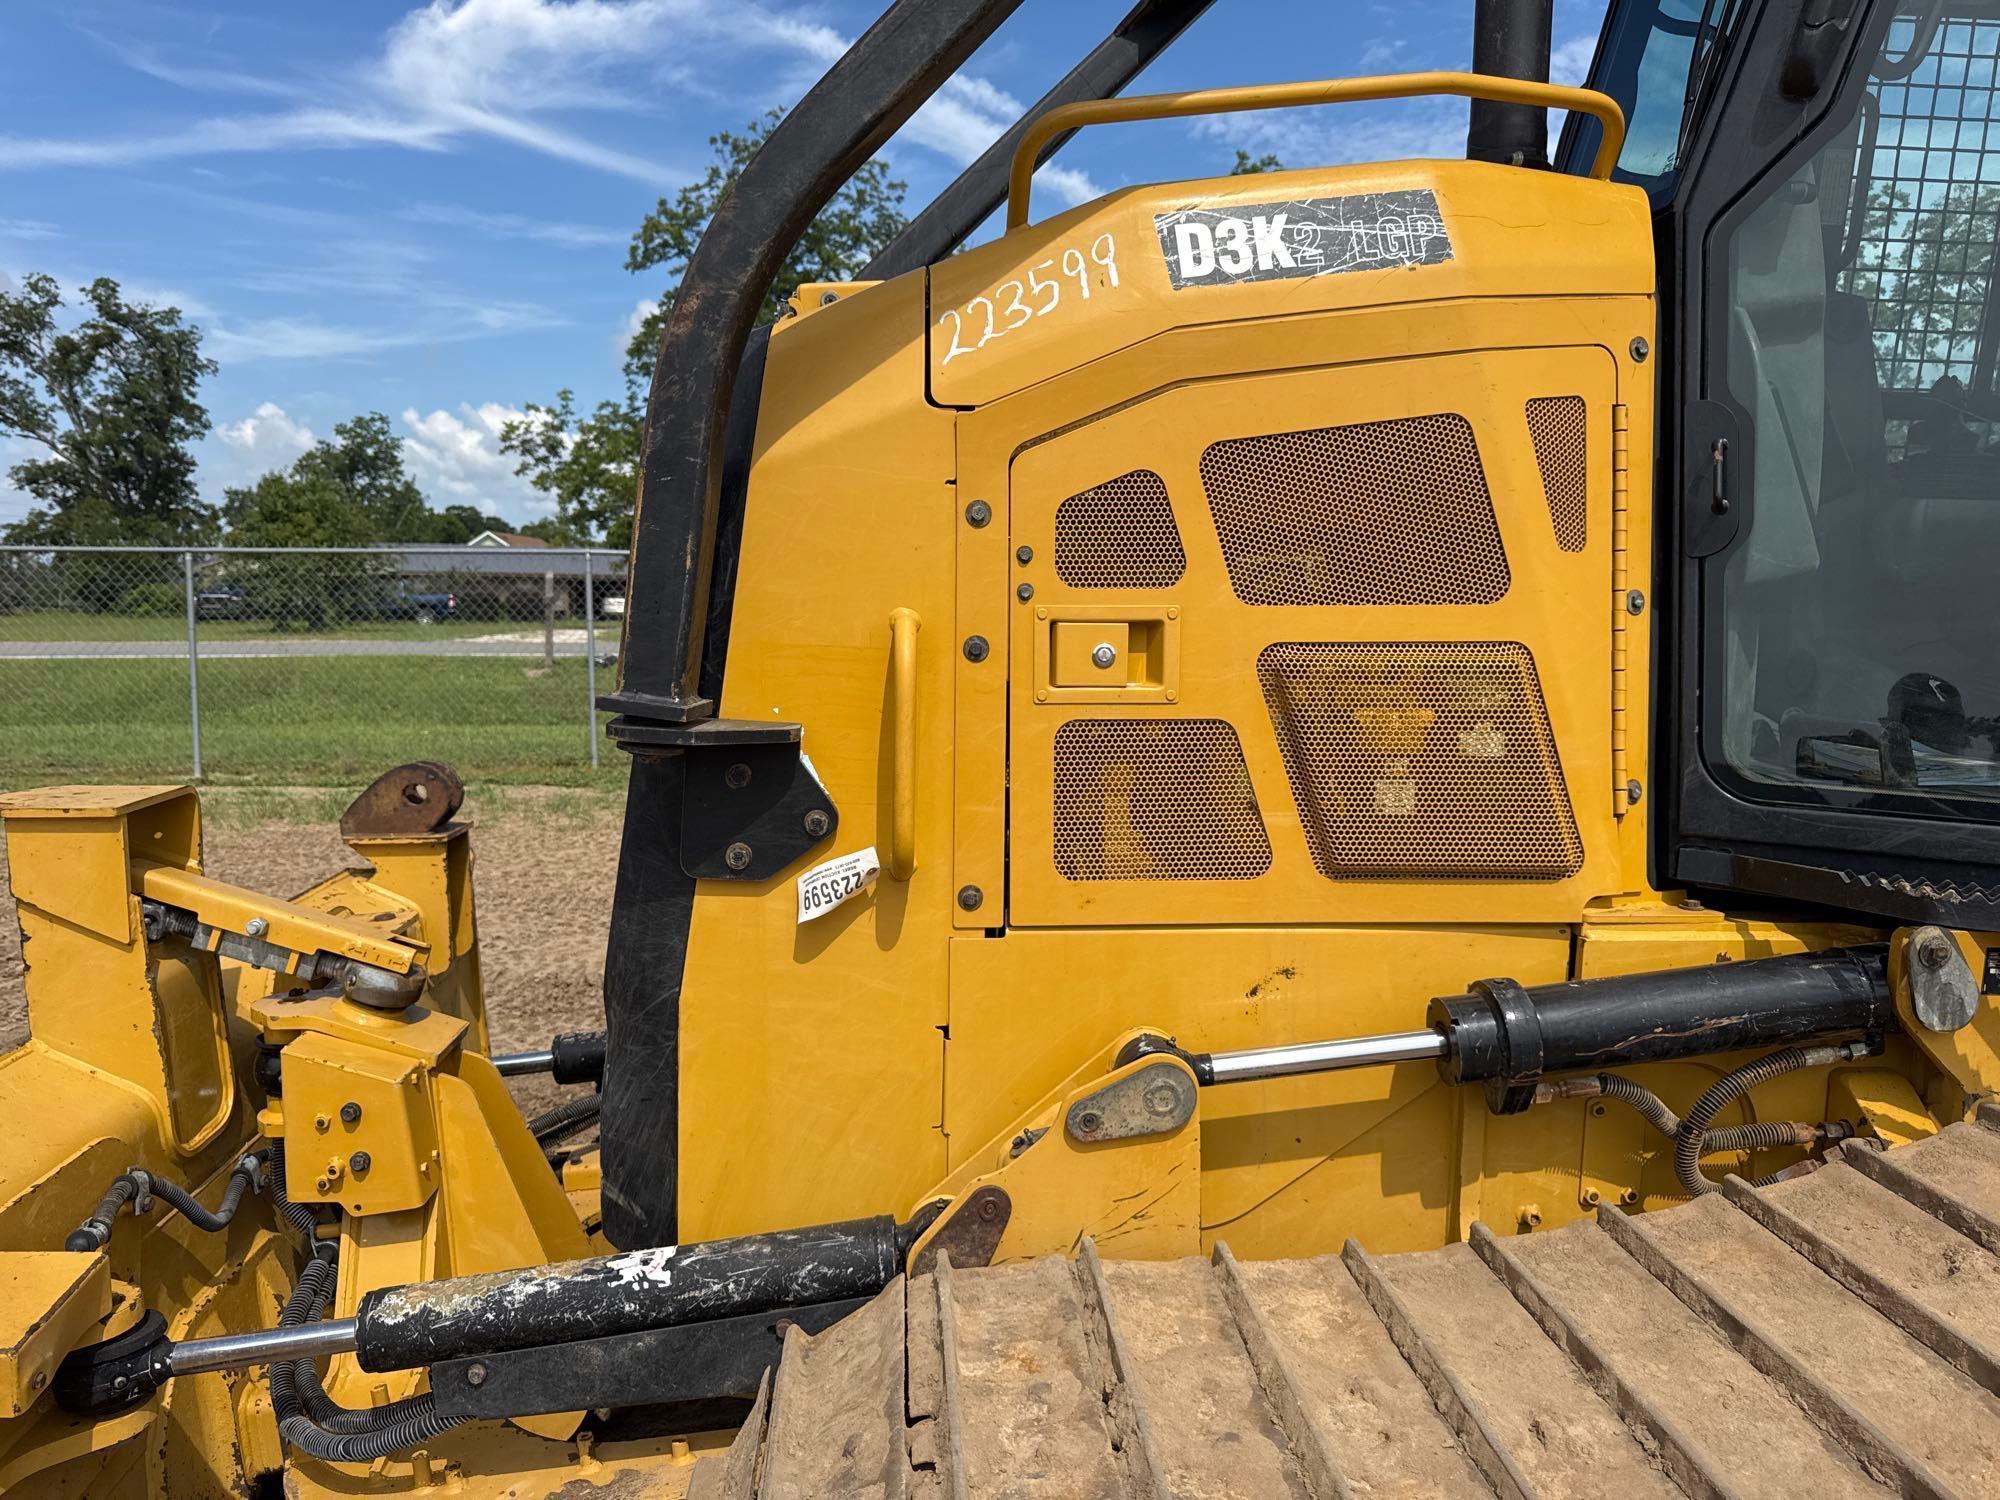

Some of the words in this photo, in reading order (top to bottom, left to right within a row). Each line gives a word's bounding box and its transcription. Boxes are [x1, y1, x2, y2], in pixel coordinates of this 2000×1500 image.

[1175, 213, 1325, 279] D3K2
[1350, 213, 1439, 263] LGP
[939, 232, 1121, 367] 223599
[804, 871, 863, 910] 223599
